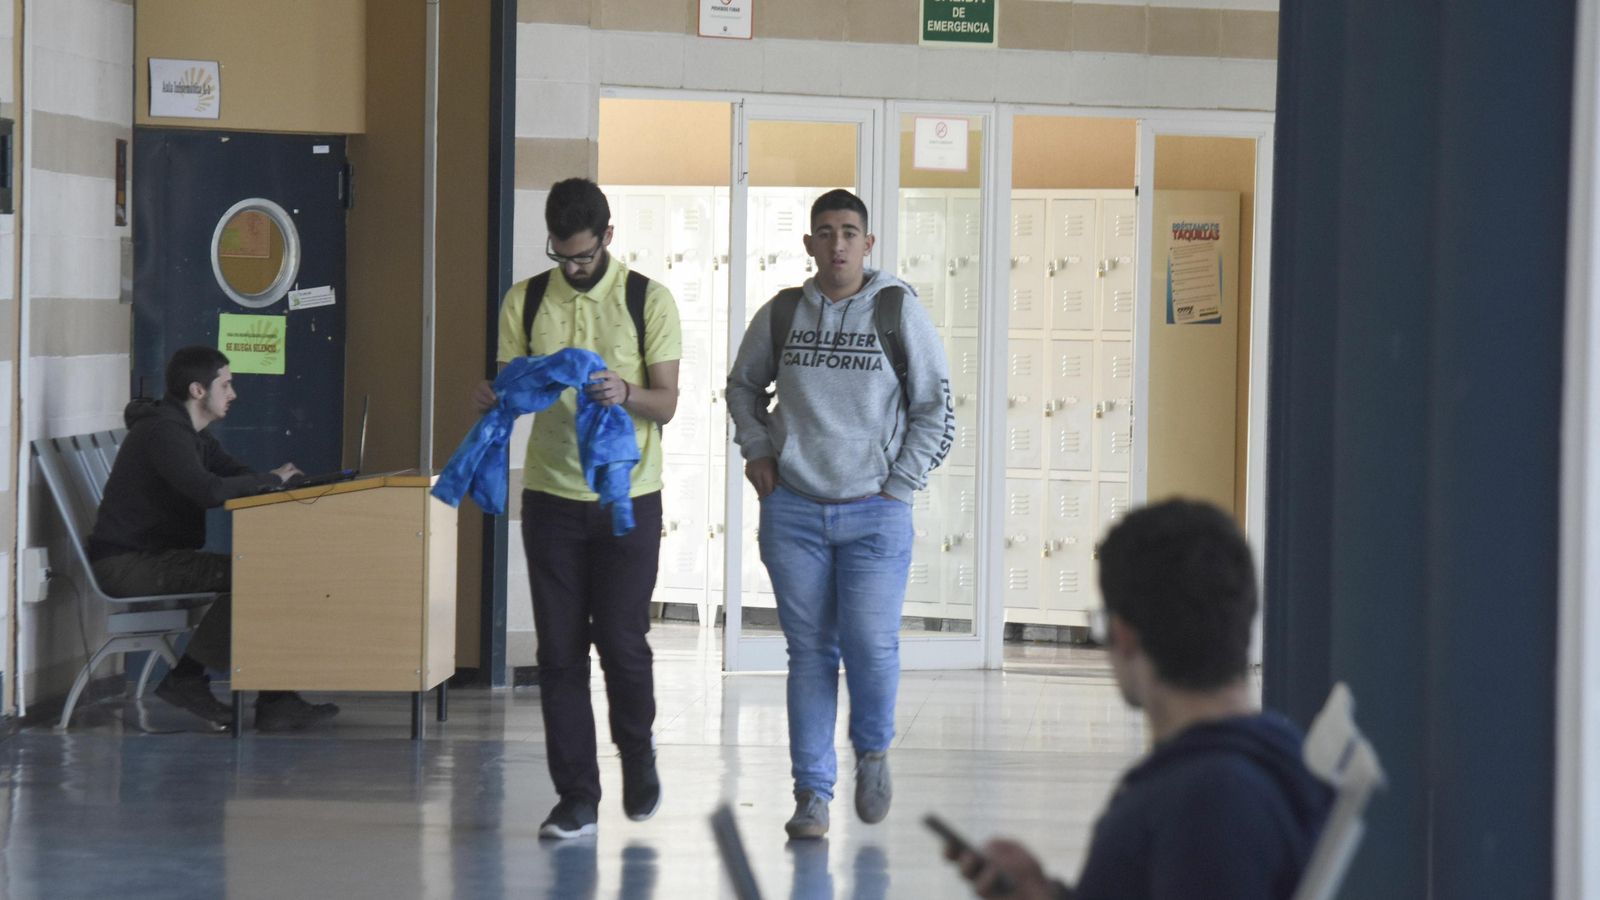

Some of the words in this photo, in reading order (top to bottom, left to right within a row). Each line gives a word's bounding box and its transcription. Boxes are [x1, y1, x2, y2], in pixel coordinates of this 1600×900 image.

[952, 7, 966, 18] DE
[927, 20, 990, 33] EMERGENCIA
[1172, 229, 1220, 241] TAQUILLAS
[790, 330, 876, 347] HOLLISTER
[784, 352, 883, 371] CALIFORNIA
